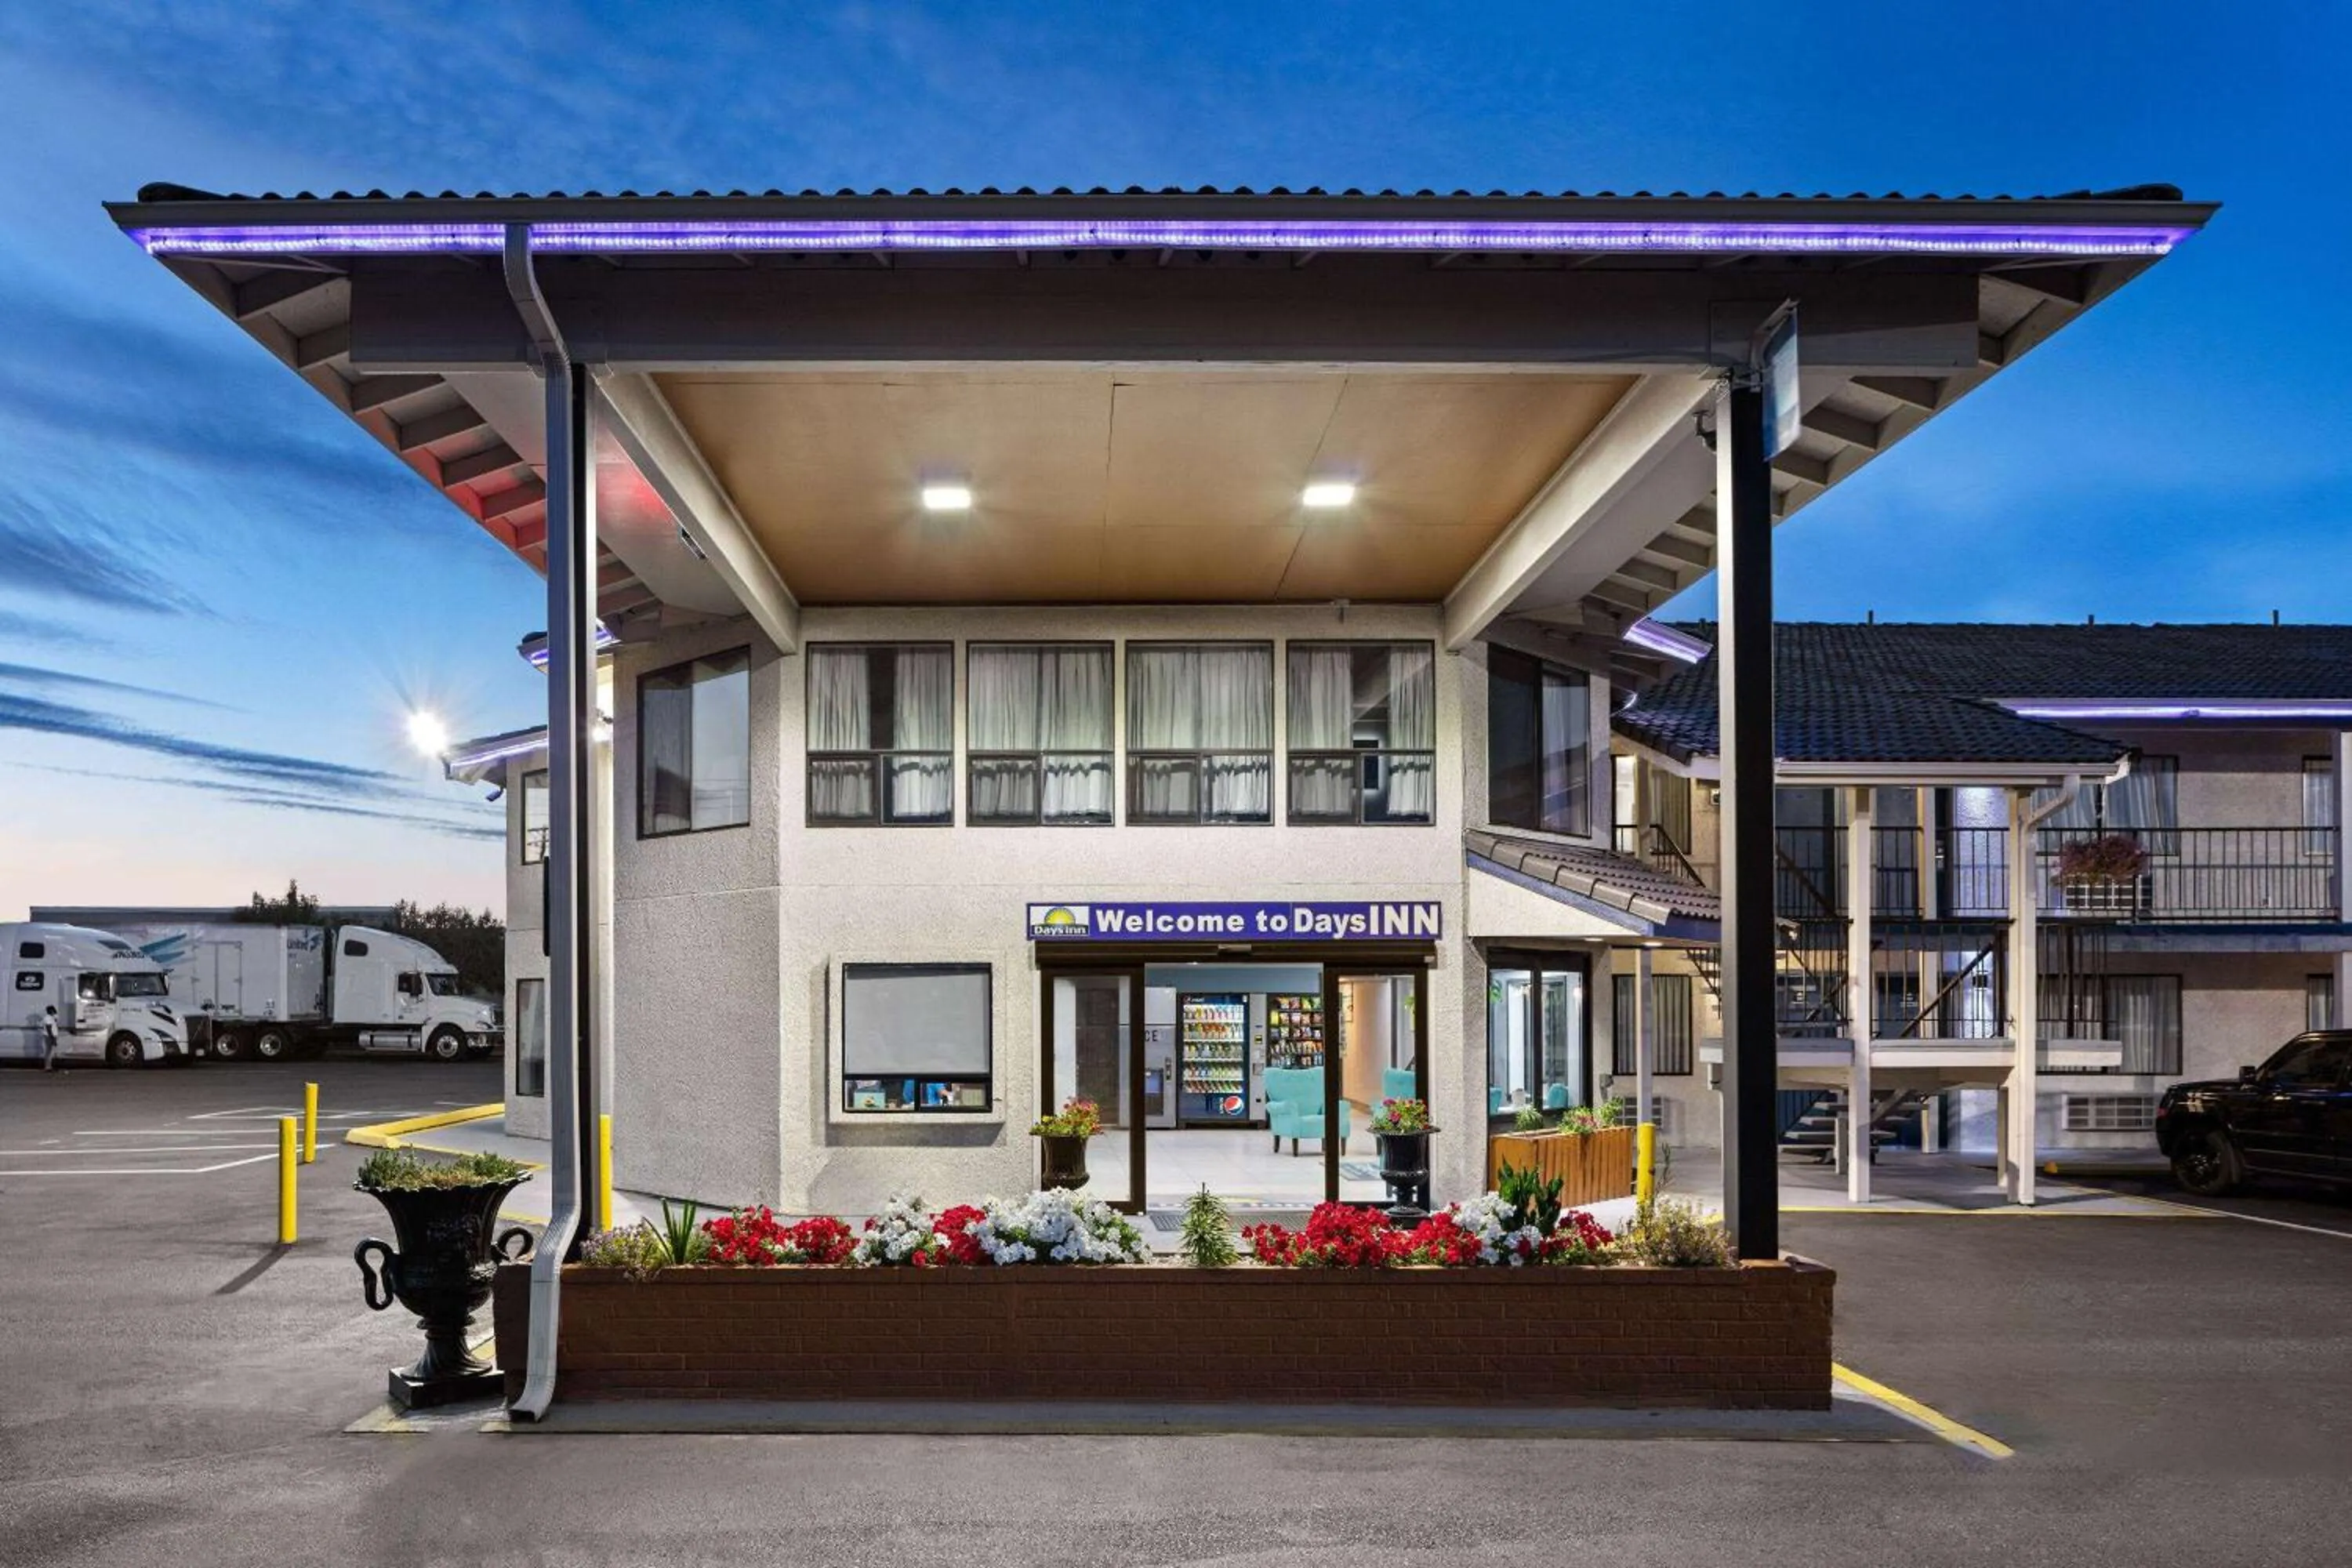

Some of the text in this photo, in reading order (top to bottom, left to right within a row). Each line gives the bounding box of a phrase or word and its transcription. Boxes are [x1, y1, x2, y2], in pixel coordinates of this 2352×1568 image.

[1096, 909, 1245, 932] Welcome
[1255, 909, 1288, 932] to
[1145, 1029, 1159, 1042] CE
